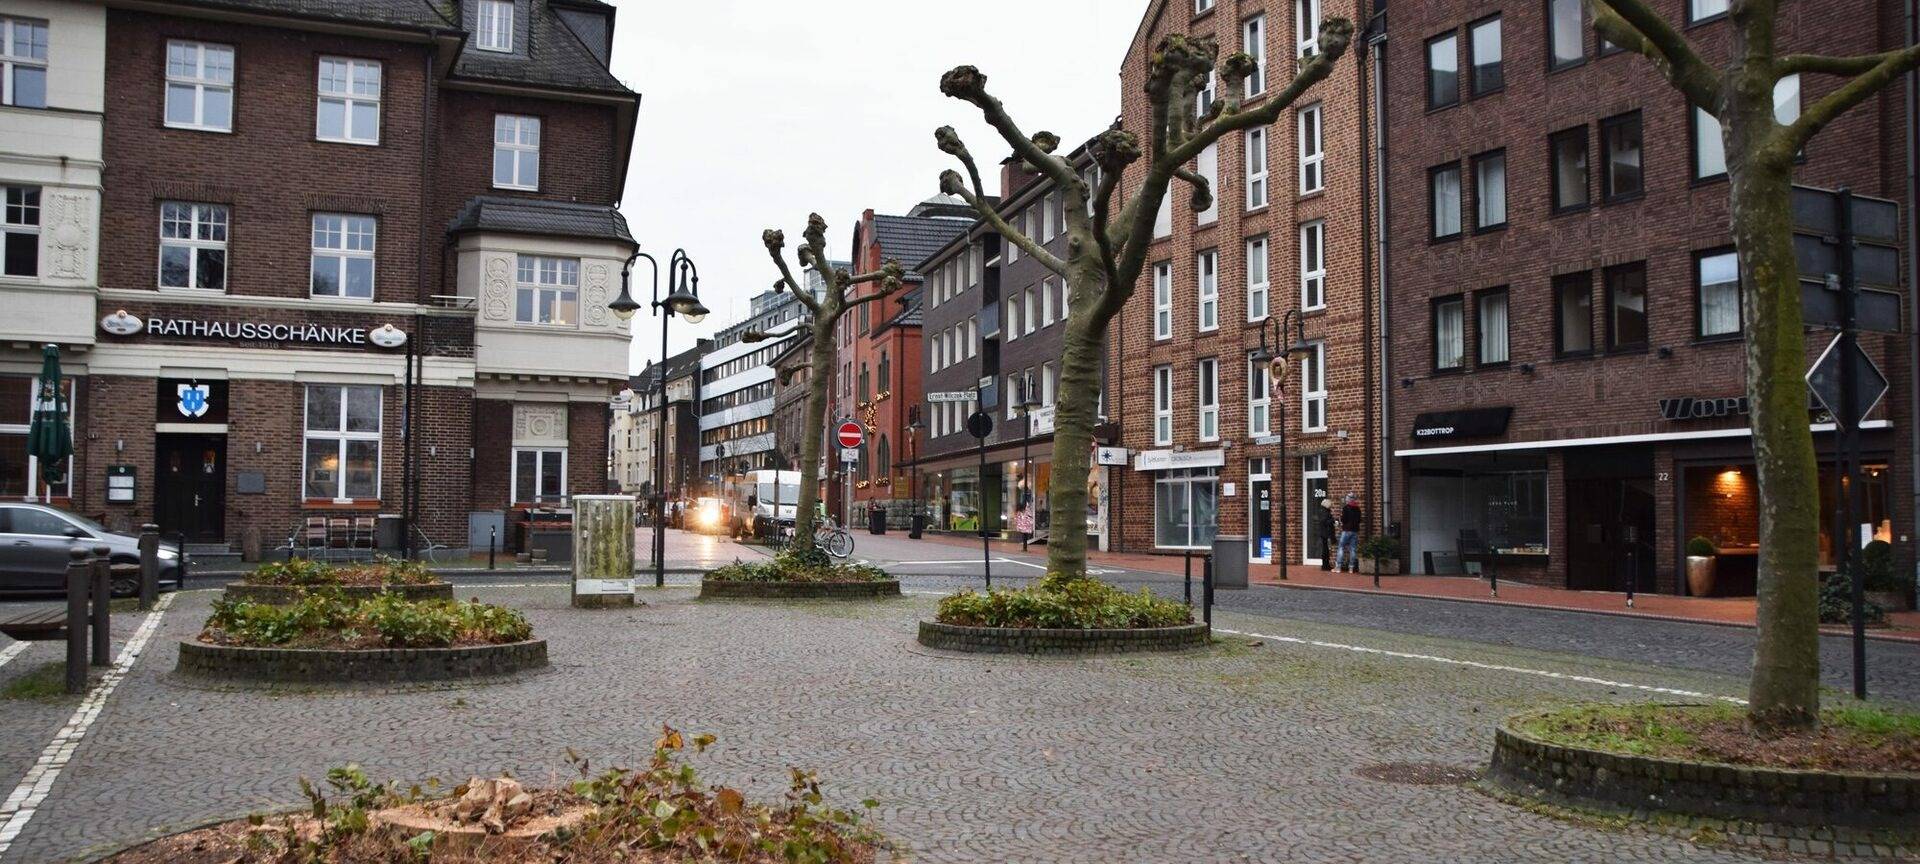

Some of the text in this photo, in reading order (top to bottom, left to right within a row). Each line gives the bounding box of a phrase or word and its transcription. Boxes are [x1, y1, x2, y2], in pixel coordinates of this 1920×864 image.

[147, 318, 366, 344] RATHAUSSCHÄNKE
[1658, 472, 1669, 481] 22
[1260, 489, 1269, 499] 20
